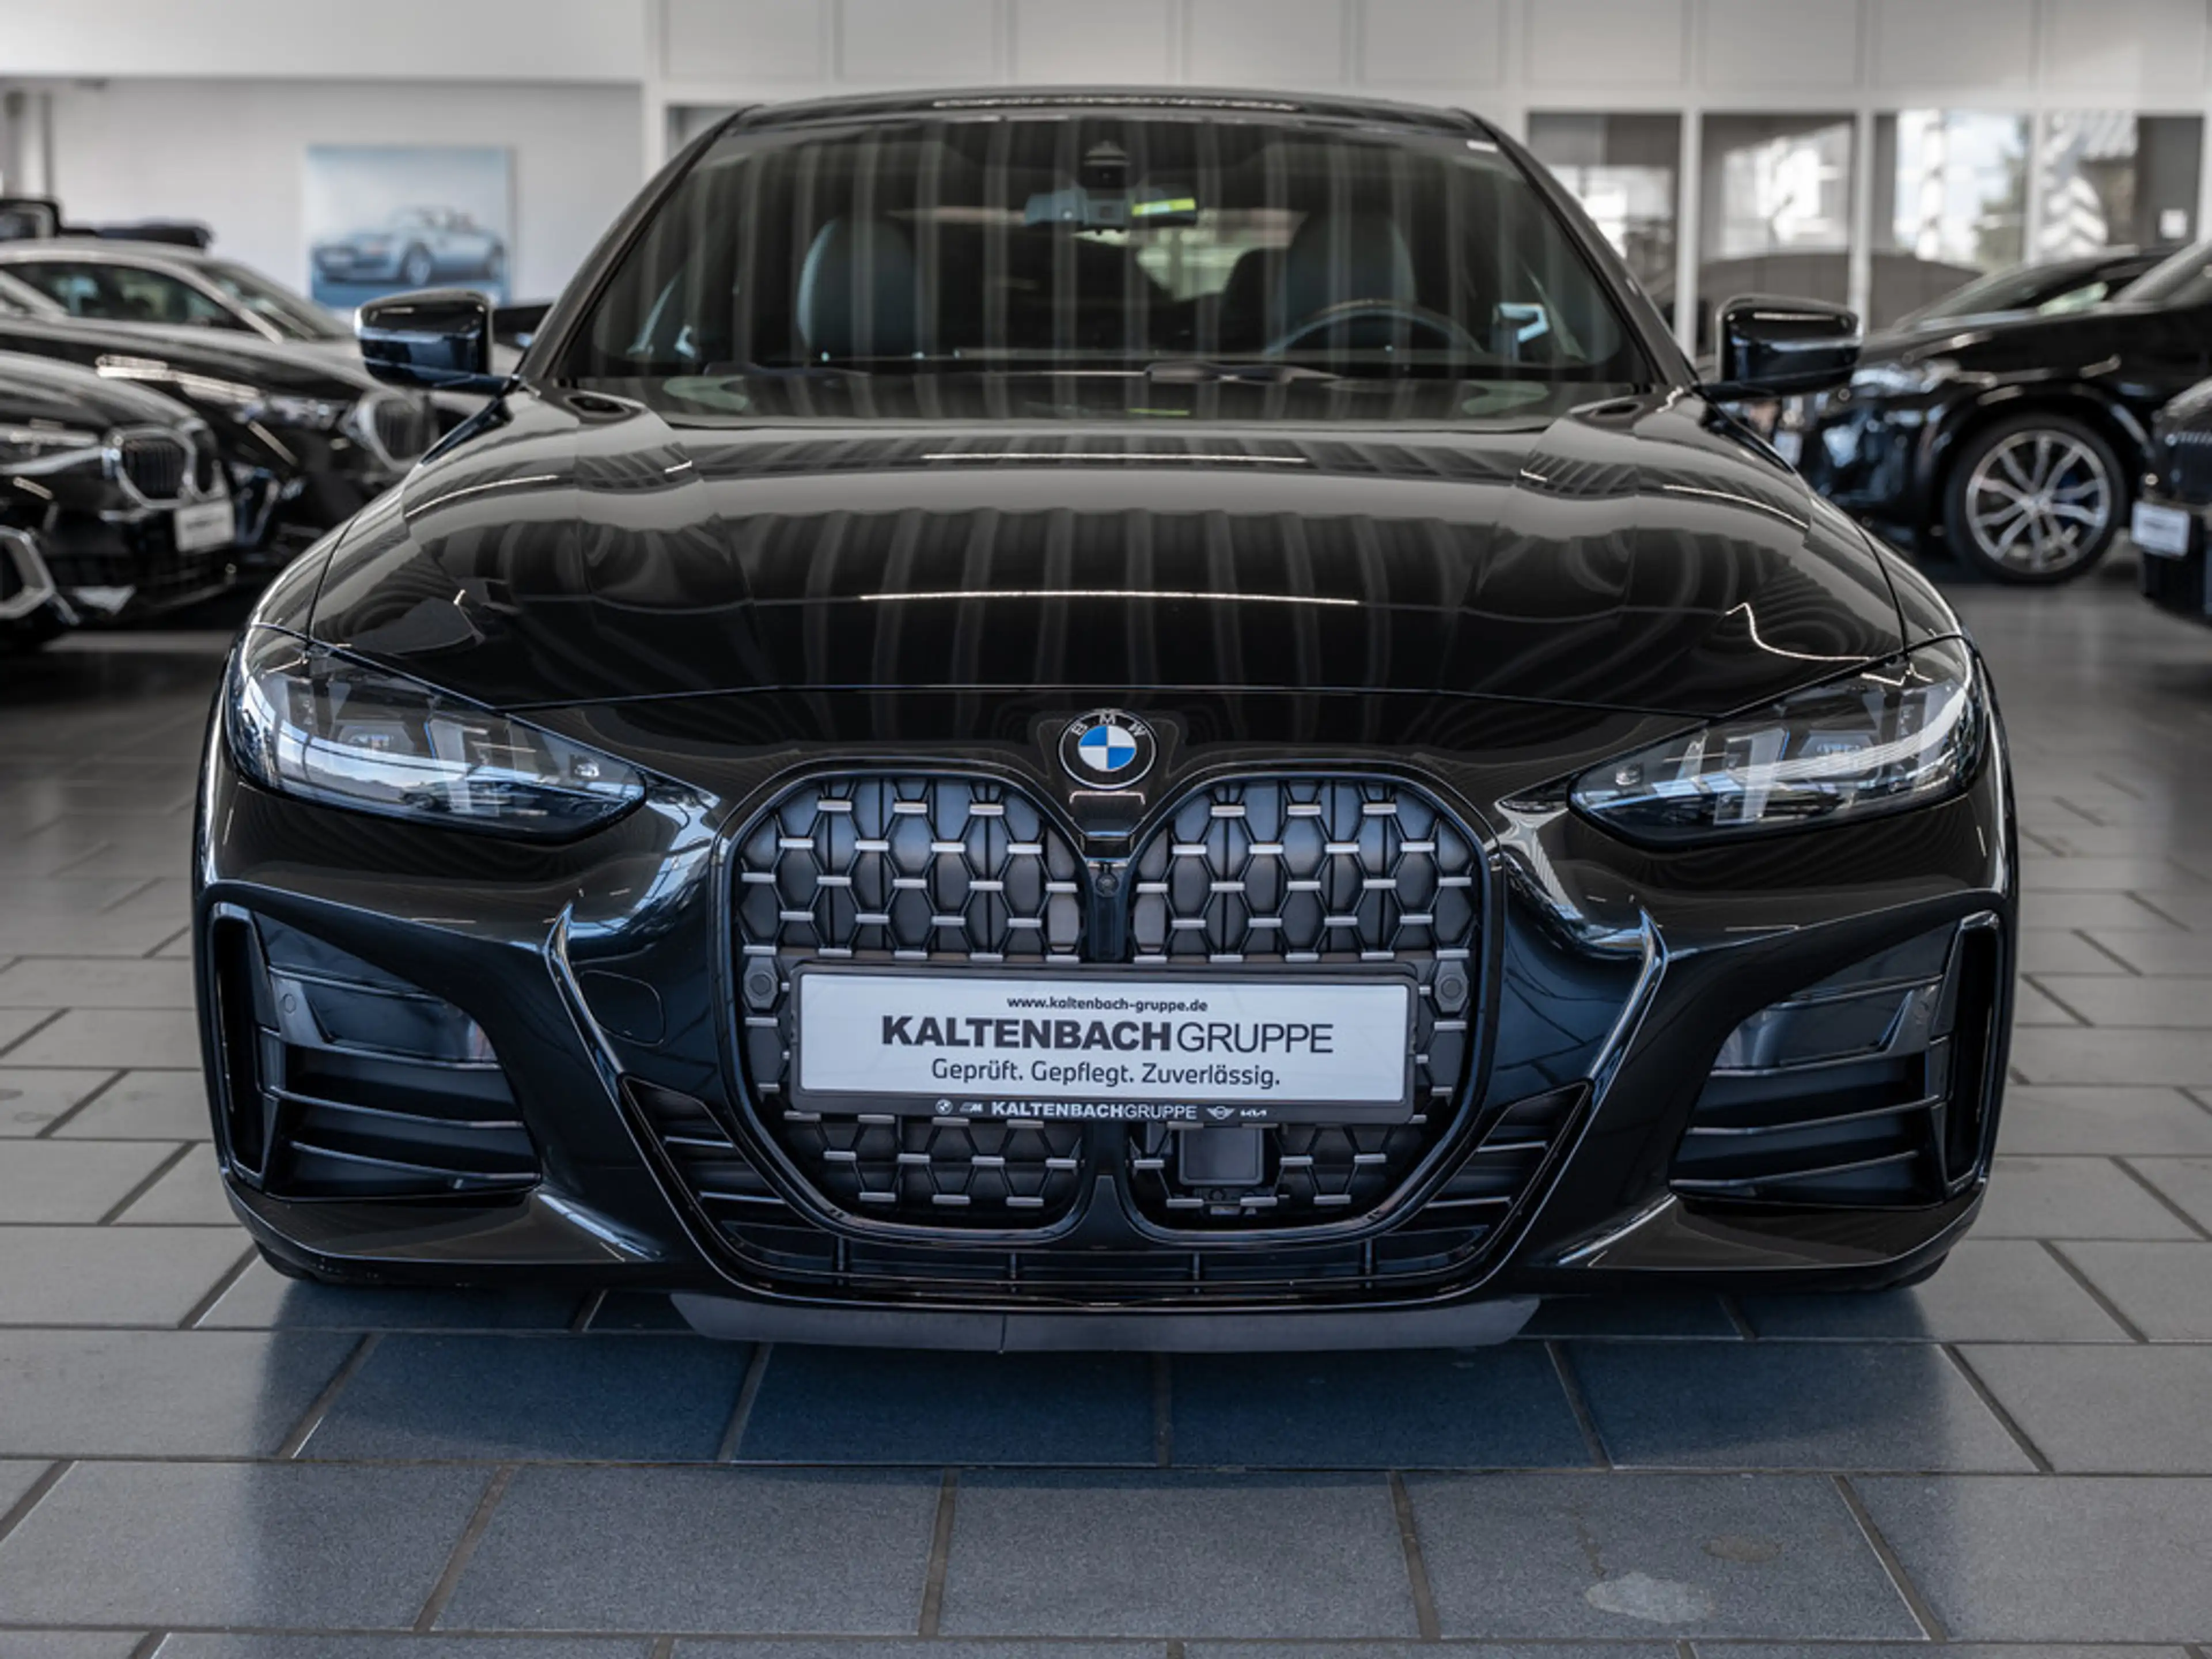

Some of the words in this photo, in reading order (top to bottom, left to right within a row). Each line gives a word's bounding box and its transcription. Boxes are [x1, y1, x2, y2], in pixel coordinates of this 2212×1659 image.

[1071, 714, 1146, 737] BMW
[1006, 996, 1209, 1013] www.kaltenbach-gruppe.de
[931, 1058, 1023, 1084] Geprüft.
[1031, 1060, 1134, 1088] Gepflegt.
[1141, 1062, 1280, 1089] Zuverlässig.
